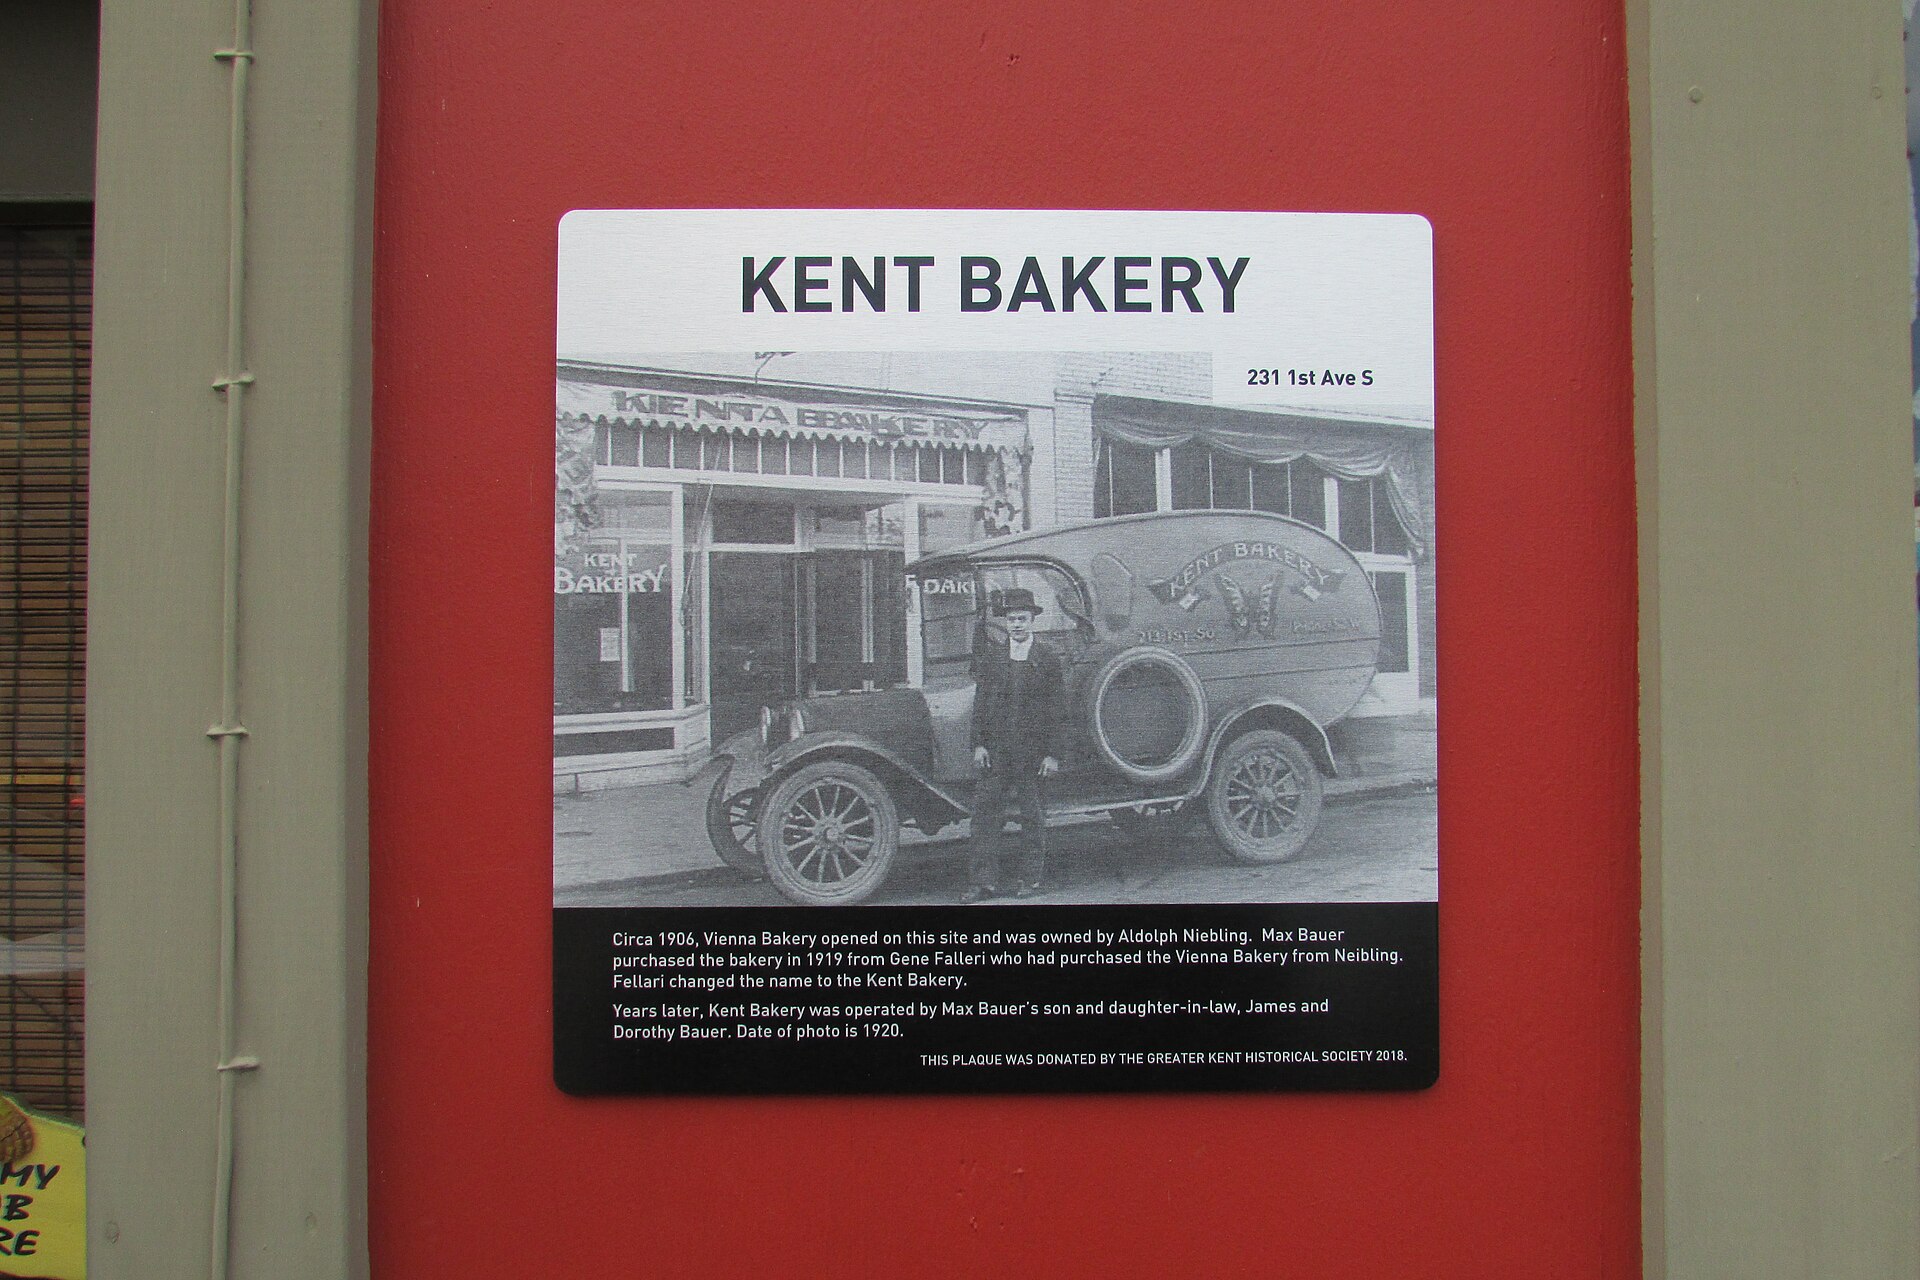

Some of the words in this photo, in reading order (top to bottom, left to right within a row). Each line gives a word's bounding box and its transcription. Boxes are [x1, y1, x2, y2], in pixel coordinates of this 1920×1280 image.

[742, 256, 935, 313] KENT
[960, 256, 1251, 313] BAKERY
[1247, 369, 1279, 386] 231
[1288, 369, 1316, 386] 1st
[1320, 369, 1356, 386] Ave
[1361, 369, 1374, 386] S
[584, 553, 637, 567] KENT
[1169, 549, 1222, 598] KENT
[1234, 542, 1330, 586] BAKERY
[555, 564, 667, 593] BAKERY
[612, 931, 653, 947] Circa
[658, 931, 699, 948] 1906,
[703, 931, 757, 946] Vienna
[761, 931, 817, 949] Bakery
[821, 930, 878, 949] opened
[882, 934, 902, 945] on
[906, 930, 936, 945] this
[939, 930, 968, 945] site
[972, 929, 1001, 944] and
[1005, 933, 1037, 944] was
[1041, 928, 1092, 944] owned
[1096, 928, 1115, 947] by
[1117, 928, 1178, 946] Aldolph
[1183, 927, 1253, 945] Niebling.
[1262, 927, 1293, 942] Max
[1298, 927, 1345, 942] Bauer
[613, 952, 695, 971] purchased
[699, 952, 725, 967] the
[729, 952, 783, 970] bakery
[787, 952, 801, 967] in
[806, 951, 843, 967] 1919
[847, 951, 885, 966] from
[890, 951, 930, 966] Gene
[934, 950, 986, 966] Falleri
[989, 950, 1022, 965] who
[1027, 950, 1055, 965] had
[1060, 949, 1142, 968] purchased
[1146, 949, 1171, 964] the
[1175, 949, 1228, 964] Vienna
[1233, 948, 1289, 966] Bakery
[1291, 948, 1330, 963] from
[1334, 947, 1403, 965] Neibling.
[613, 973, 665, 989] Fellari
[669, 973, 735, 992] changed
[739, 973, 765, 988] the
[769, 976, 813, 988] name
[816, 974, 832, 988] to
[836, 972, 862, 987] the
[866, 972, 903, 987] Kent
[908, 972, 967, 990] Bakery.
[612, 1003, 658, 1018] Years
[662, 1003, 704, 1020] later,
[709, 1003, 745, 1018] Kent
[750, 1002, 806, 1021] Bakery
[808, 1005, 841, 1017] was
[844, 1001, 915, 1020] operated
[919, 1001, 938, 1020] by
[942, 1001, 974, 1016] Max
[978, 1001, 1039, 1016] Bauer's
[1043, 1004, 1071, 1015] son
[1075, 1000, 1104, 1015] and
[1108, 999, 1241, 1017] daughter-in-law,
[1245, 999, 1297, 1013] James
[1300, 998, 1329, 1013] and
[613, 1024, 676, 1043] Dorothy
[680, 1024, 732, 1039] Bauer.
[737, 1023, 773, 1039] Date
[777, 1023, 792, 1038] of
[796, 1023, 840, 1042] photo
[845, 1023, 858, 1038] is
[863, 1023, 904, 1038] 1920.
[919, 1054, 949, 1066] THIS
[952, 1053, 1003, 1066] PLAQUE
[1005, 1053, 1034, 1066] WAS
[1037, 1053, 1097, 1065] DONATED
[1100, 1052, 1117, 1065] BY
[1118, 1052, 1144, 1065] THE
[1147, 1052, 1205, 1064] GREATER
[1208, 1051, 1242, 1064] KENT
[1245, 1050, 1319, 1063] HISTORICAL
[1321, 1050, 1373, 1062] SOCIETY
[1375, 1049, 1408, 1062] 2018.
[0, 1194, 34, 1221] B
